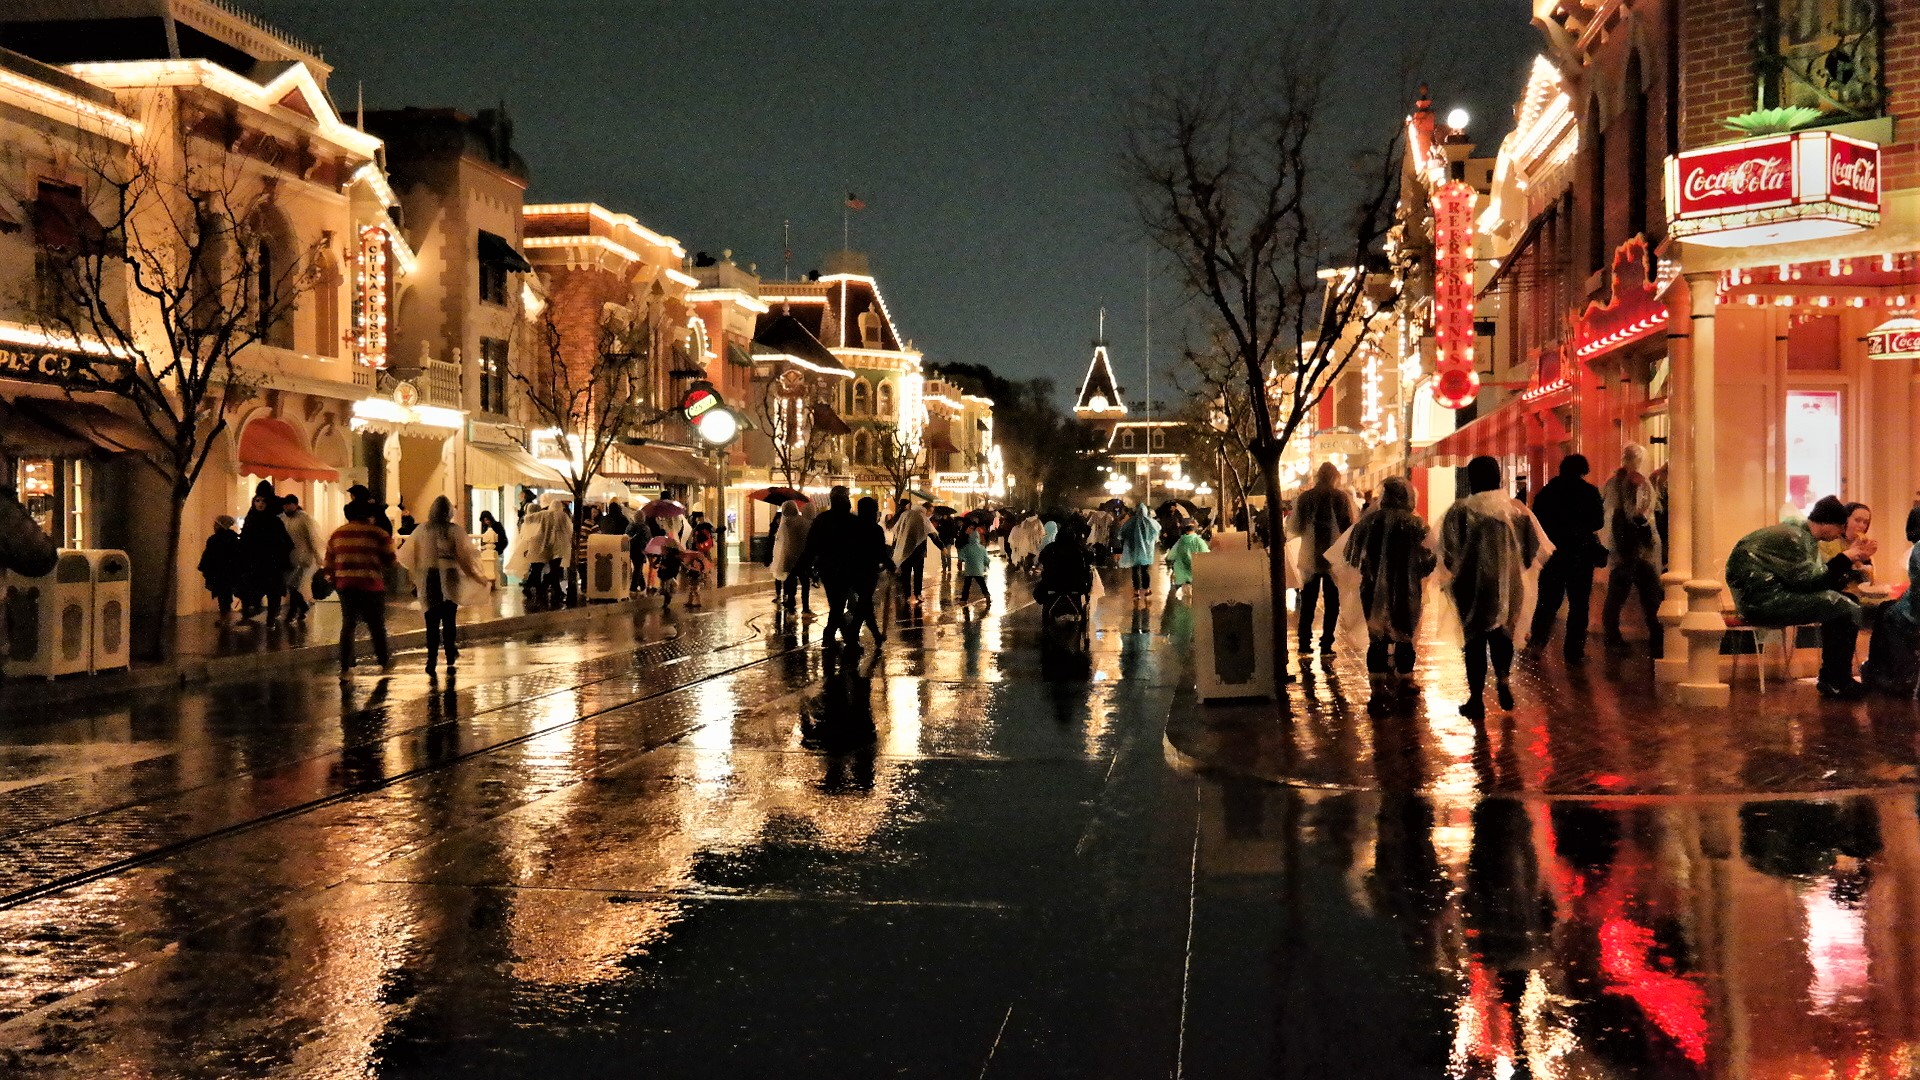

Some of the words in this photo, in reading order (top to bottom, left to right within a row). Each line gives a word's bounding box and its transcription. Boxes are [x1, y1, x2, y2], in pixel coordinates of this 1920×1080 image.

[1684, 156, 1784, 200] Coca-Cola
[368, 245, 379, 290] CHINA
[1448, 201, 1463, 366] REFRESHMENTS
[368, 295, 379, 349] CLOSET
